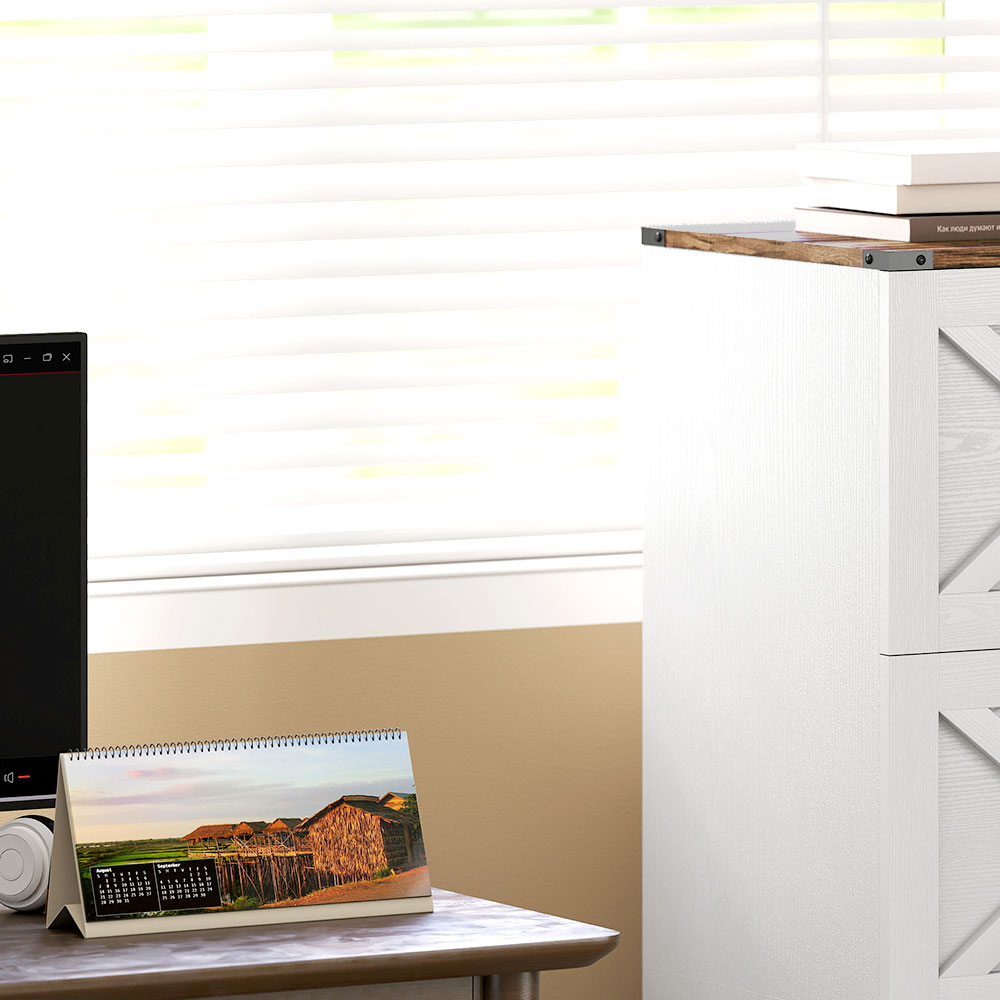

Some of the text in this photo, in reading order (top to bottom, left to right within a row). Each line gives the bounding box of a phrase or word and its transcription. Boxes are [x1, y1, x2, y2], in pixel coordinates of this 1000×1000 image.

[936, 225, 949, 233] Как
[950, 225, 968, 233] люди
[969, 224, 995, 233] думают
